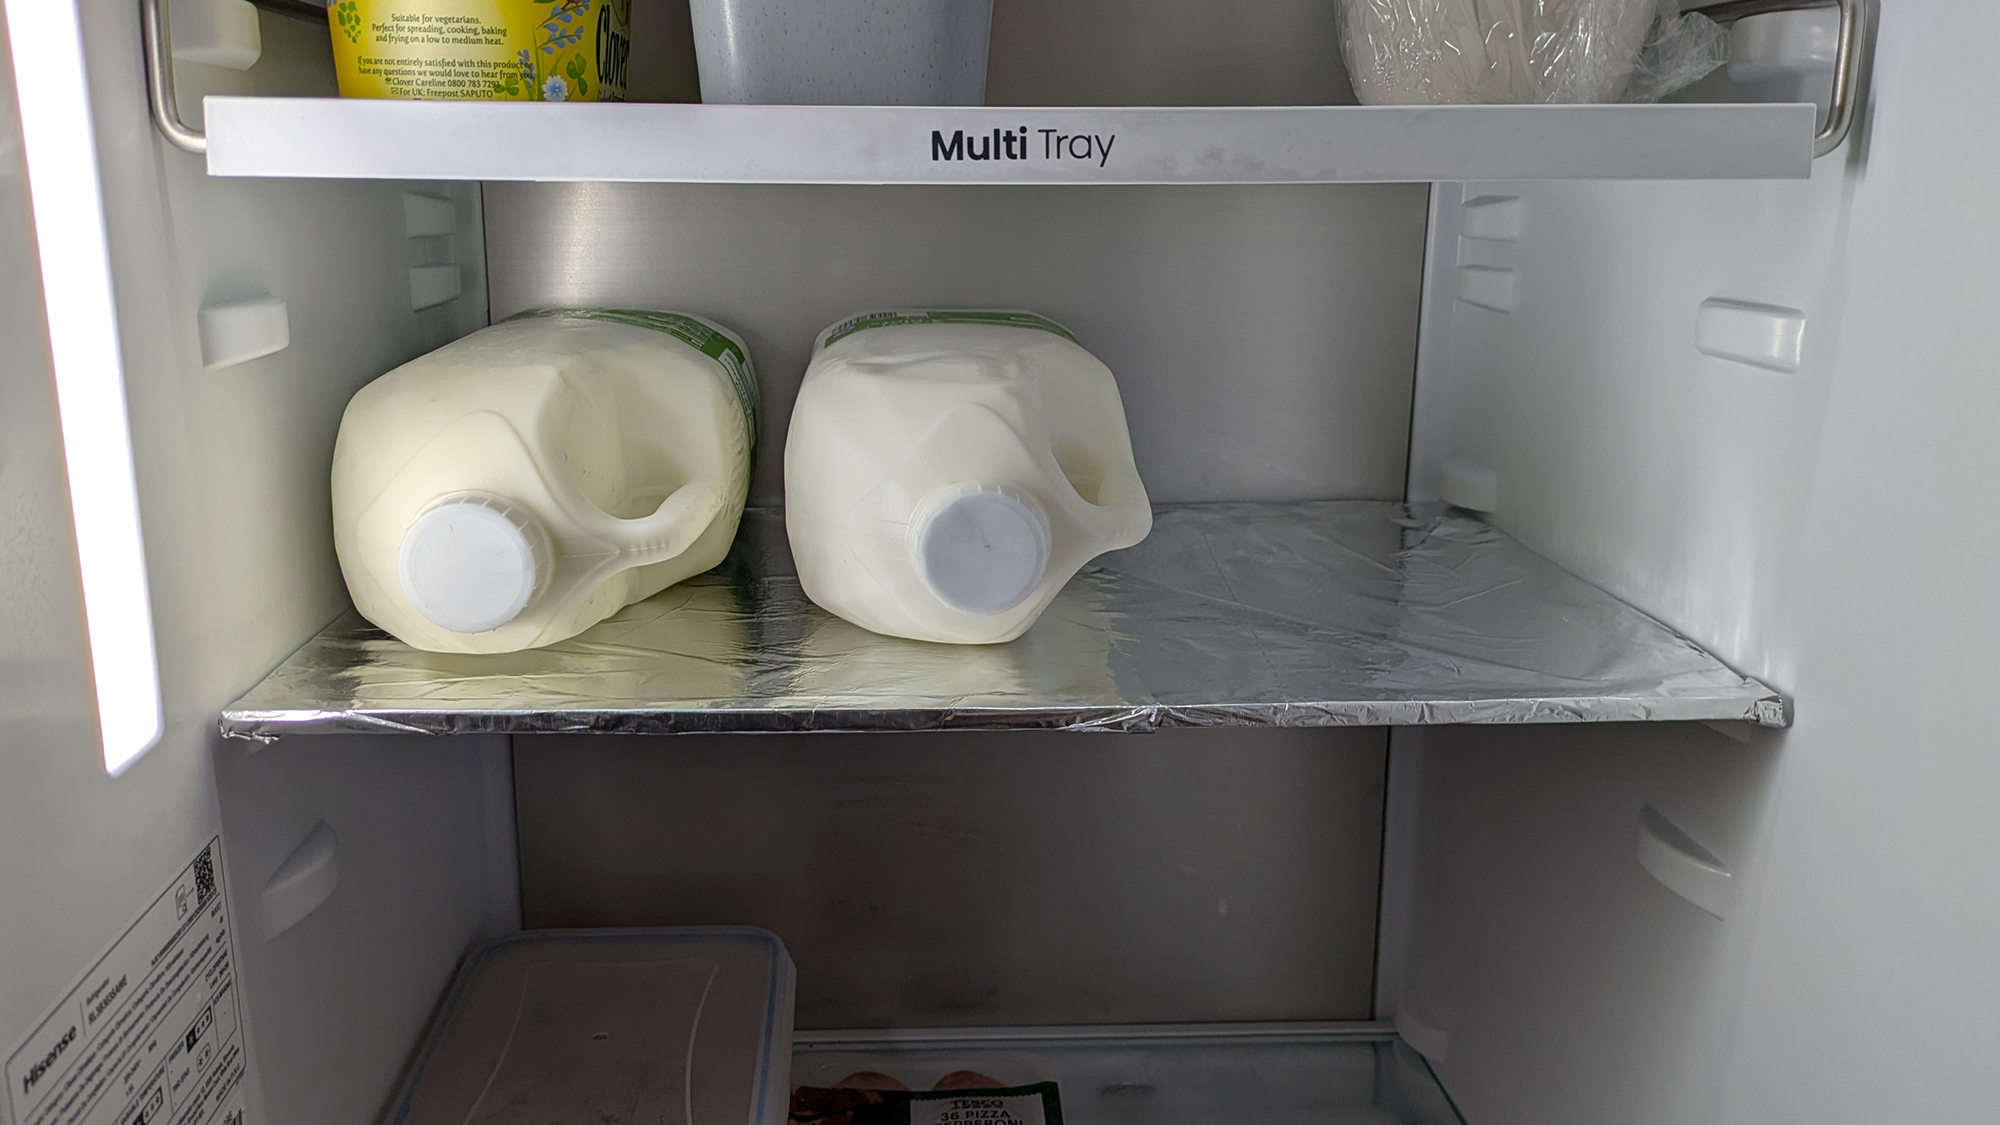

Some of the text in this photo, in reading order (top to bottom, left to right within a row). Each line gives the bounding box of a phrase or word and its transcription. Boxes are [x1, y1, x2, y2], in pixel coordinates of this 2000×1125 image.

[391, 14, 482, 25] Suitable for vegetarians.
[372, 23, 507, 37] Perfect for spreading, cooking, baking
[376, 34, 388, 42] and
[388, 34, 410, 44] frying
[426, 34, 440, 43] low
[452, 36, 484, 44] medium
[484, 36, 504, 45] heat.
[596, 4, 630, 90] Clover
[358, 56, 362, 66] If
[362, 58, 372, 66] you
[396, 58, 424, 68] entirely
[424, 58, 456, 68] satisfied
[457, 59, 476, 68] with
[476, 60, 492, 68] this
[493, 60, 523, 70] product
[358, 66, 372, 74] have
[372, 68, 382, 76] any
[384, 68, 416, 76] questions
[428, 68, 452, 78] would
[454, 69, 470, 78] love
[481, 70, 498, 78] hear
[499, 70, 518, 80] from
[392, 77, 414, 86] Clover
[415, 78, 446, 87] Careline
[448, 79, 466, 88] 0800
[468, 80, 480, 88] 783
[400, 88, 494, 98] For UK: Freepost SAPUTO
[932, 126, 1116, 168] Multi Tray
[22, 1025, 76, 1095] Hisense
[950, 1099, 1004, 1108] TESCO
[941, 1110, 1010, 1122] 36 PIZZA
